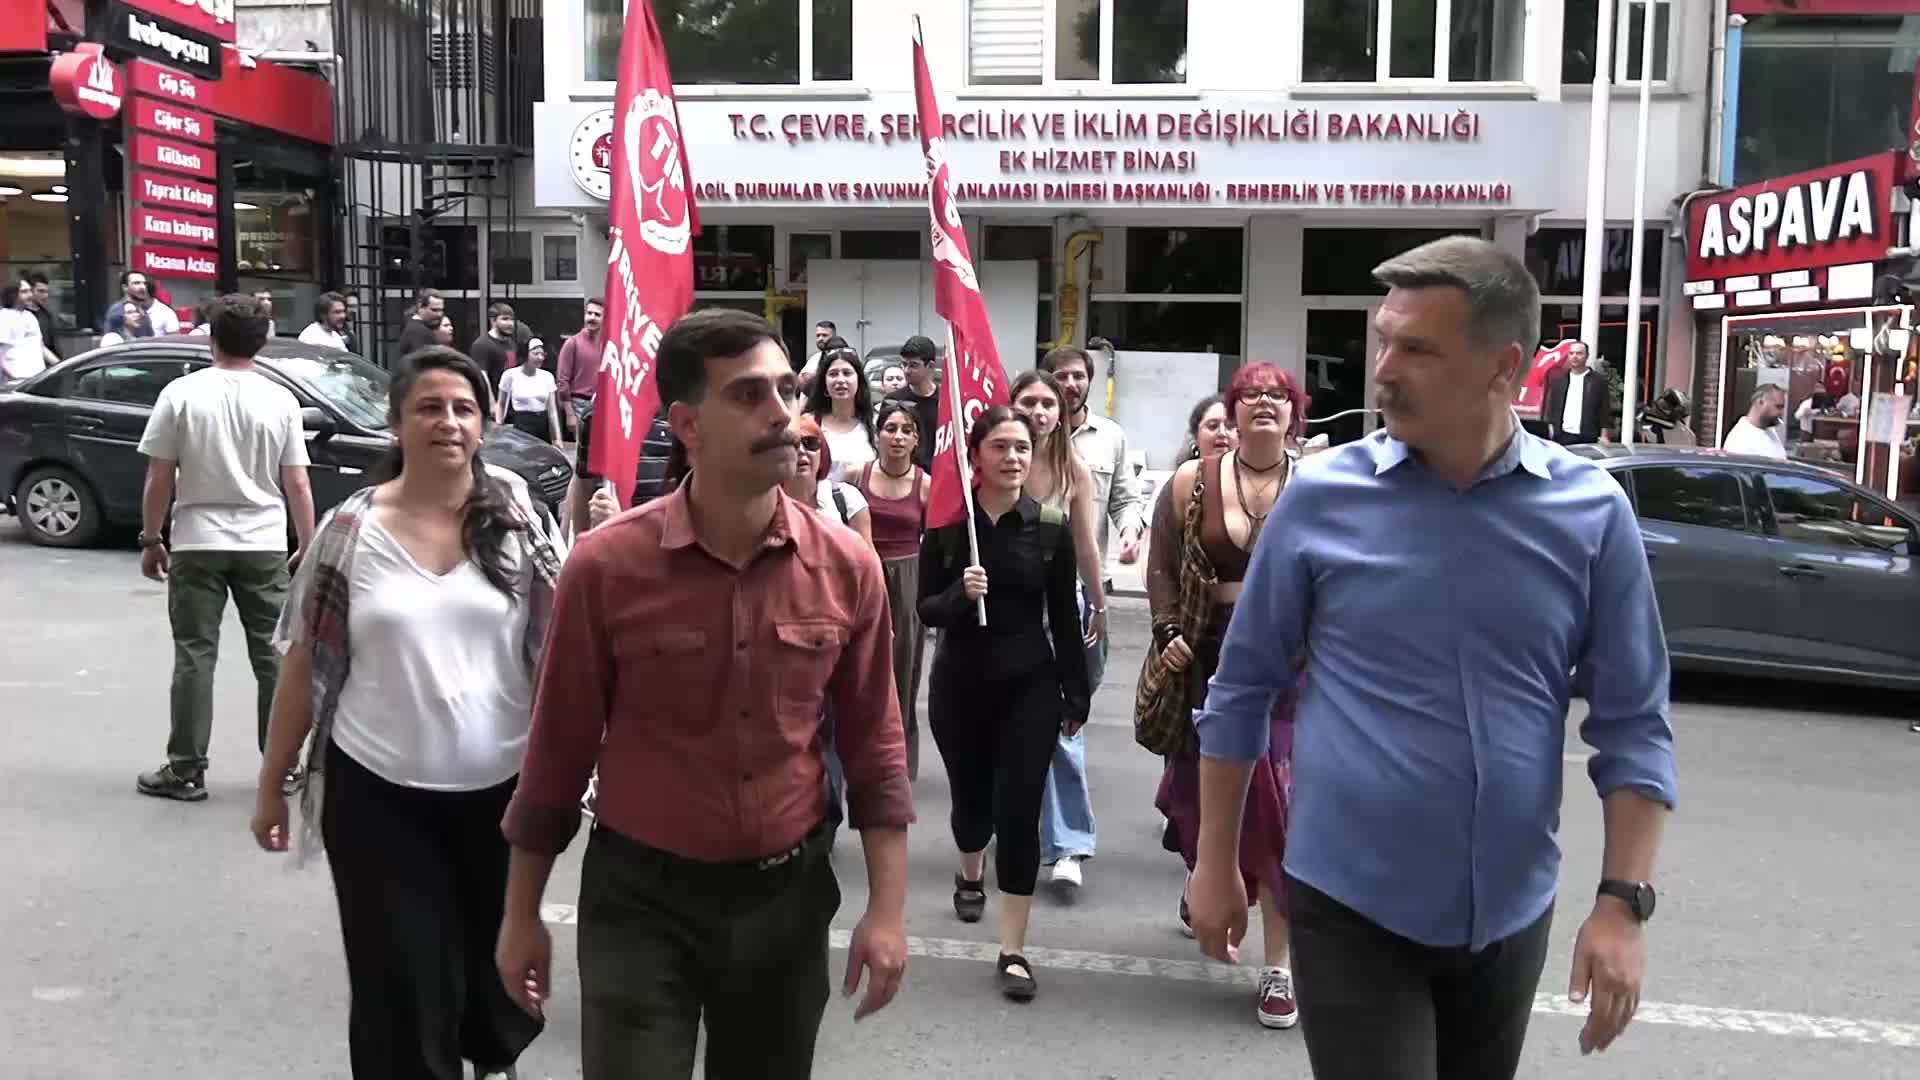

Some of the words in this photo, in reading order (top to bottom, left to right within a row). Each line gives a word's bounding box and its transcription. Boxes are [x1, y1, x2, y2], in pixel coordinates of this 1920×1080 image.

[728, 113, 774, 138] T.C.
[781, 113, 875, 146] ÇEVRE,
[880, 108, 1026, 146] ŞERCİLİK
[1032, 113, 1066, 139] VE
[1074, 109, 1148, 139] İKLİM
[1157, 108, 1319, 146] DEĞİŞİKLİĞİ
[1327, 108, 1481, 140] BAKANLIĞI
[1000, 150, 1026, 172] EK
[1033, 148, 1117, 172] HİZMET
[1123, 148, 1197, 172] BİNASI
[695, 180, 730, 200] ACİL
[735, 182, 824, 200] DURUMLAR
[828, 182, 849, 200] VE
[853, 182, 929, 200] SAVUNMA
[956, 182, 1037, 200] ANLAMASI
[1043, 181, 1107, 200] DAİRESİ
[1113, 181, 1210, 205] BAŞKANLIĞI
[1227, 181, 1319, 200] REHBERLİK
[1324, 182, 1345, 200] VE
[1411, 181, 1512, 206] BAŞKANLIĞI
[1700, 170, 1873, 259] ASPAVA
